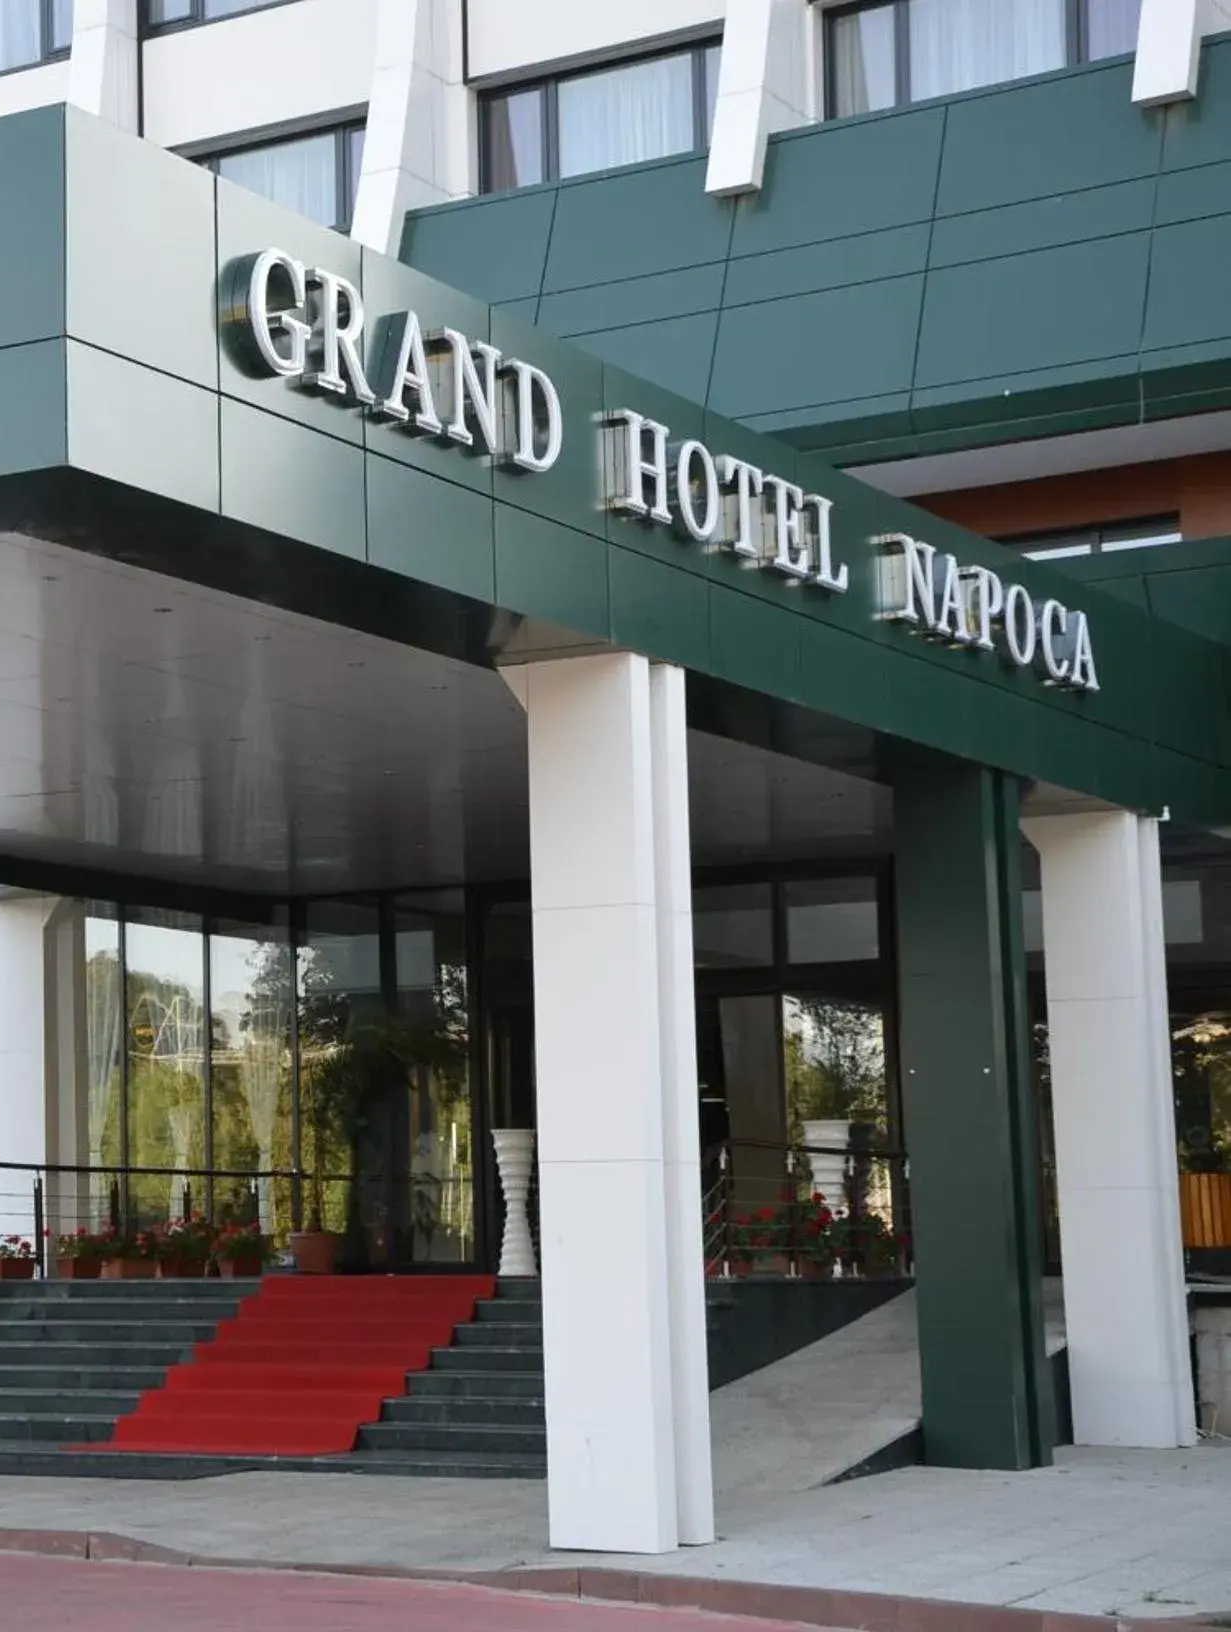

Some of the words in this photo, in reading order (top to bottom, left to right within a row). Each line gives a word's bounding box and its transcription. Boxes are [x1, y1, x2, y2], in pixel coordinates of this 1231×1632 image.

[248, 246, 564, 473] GRAND
[614, 407, 849, 593] HOTEL
[892, 532, 1101, 692] NAPOCA
